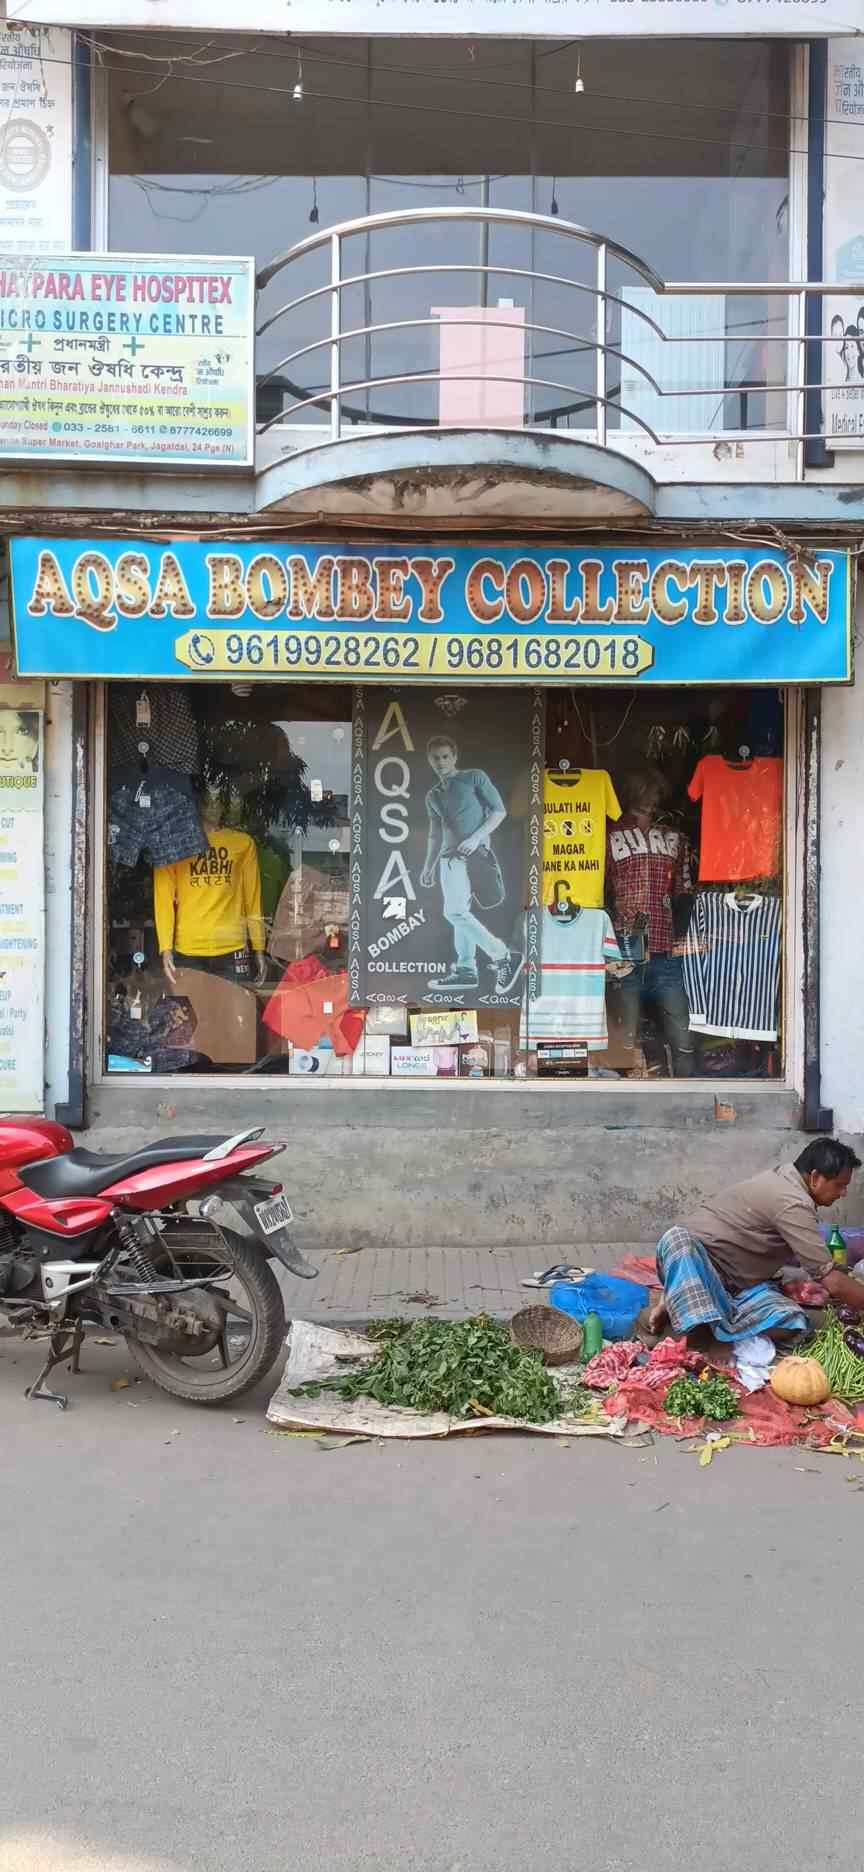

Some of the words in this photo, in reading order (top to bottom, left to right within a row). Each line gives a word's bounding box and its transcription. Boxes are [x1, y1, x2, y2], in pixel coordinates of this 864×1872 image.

[91, 274, 128, 302] EYE
[132, 275, 233, 304] HOSPITEX
[52, 310, 142, 332] SURGERY
[150, 313, 224, 334] CENTRE
[48, 361, 81, 376] জন
[139, 364, 185, 383] কেন্দ্র
[153, 383, 188, 395] Kendra
[63, 422, 84, 432] 033
[27, 551, 197, 632] AQSA
[205, 554, 456, 623] BOMBEY
[464, 558, 835, 626] COLLECTION
[225, 633, 420, 667] 9619928262
[446, 637, 640, 669] 9681682018
[352, 763, 364, 806] AQSA
[371, 701, 417, 901] AQSA
[530, 762, 541, 805] AQSA
[576, 801, 591, 813] HAI
[352, 811, 363, 855] AQSA
[529, 814, 540, 857] AQSA
[552, 844, 585, 855] MAGAR
[190, 860, 233, 876] KABHI
[351, 861, 362, 905] AQSA
[528, 863, 539, 907] AQSA
[564, 860, 577, 871] KA
[578, 859, 600, 871] NAHI
[350, 909, 361, 953] AQSA
[367, 908, 427, 959] BOMBAY
[528, 913, 538, 957] AQSA
[349, 957, 361, 1001] AQSA
[367, 961, 447, 974] COLLECTION
